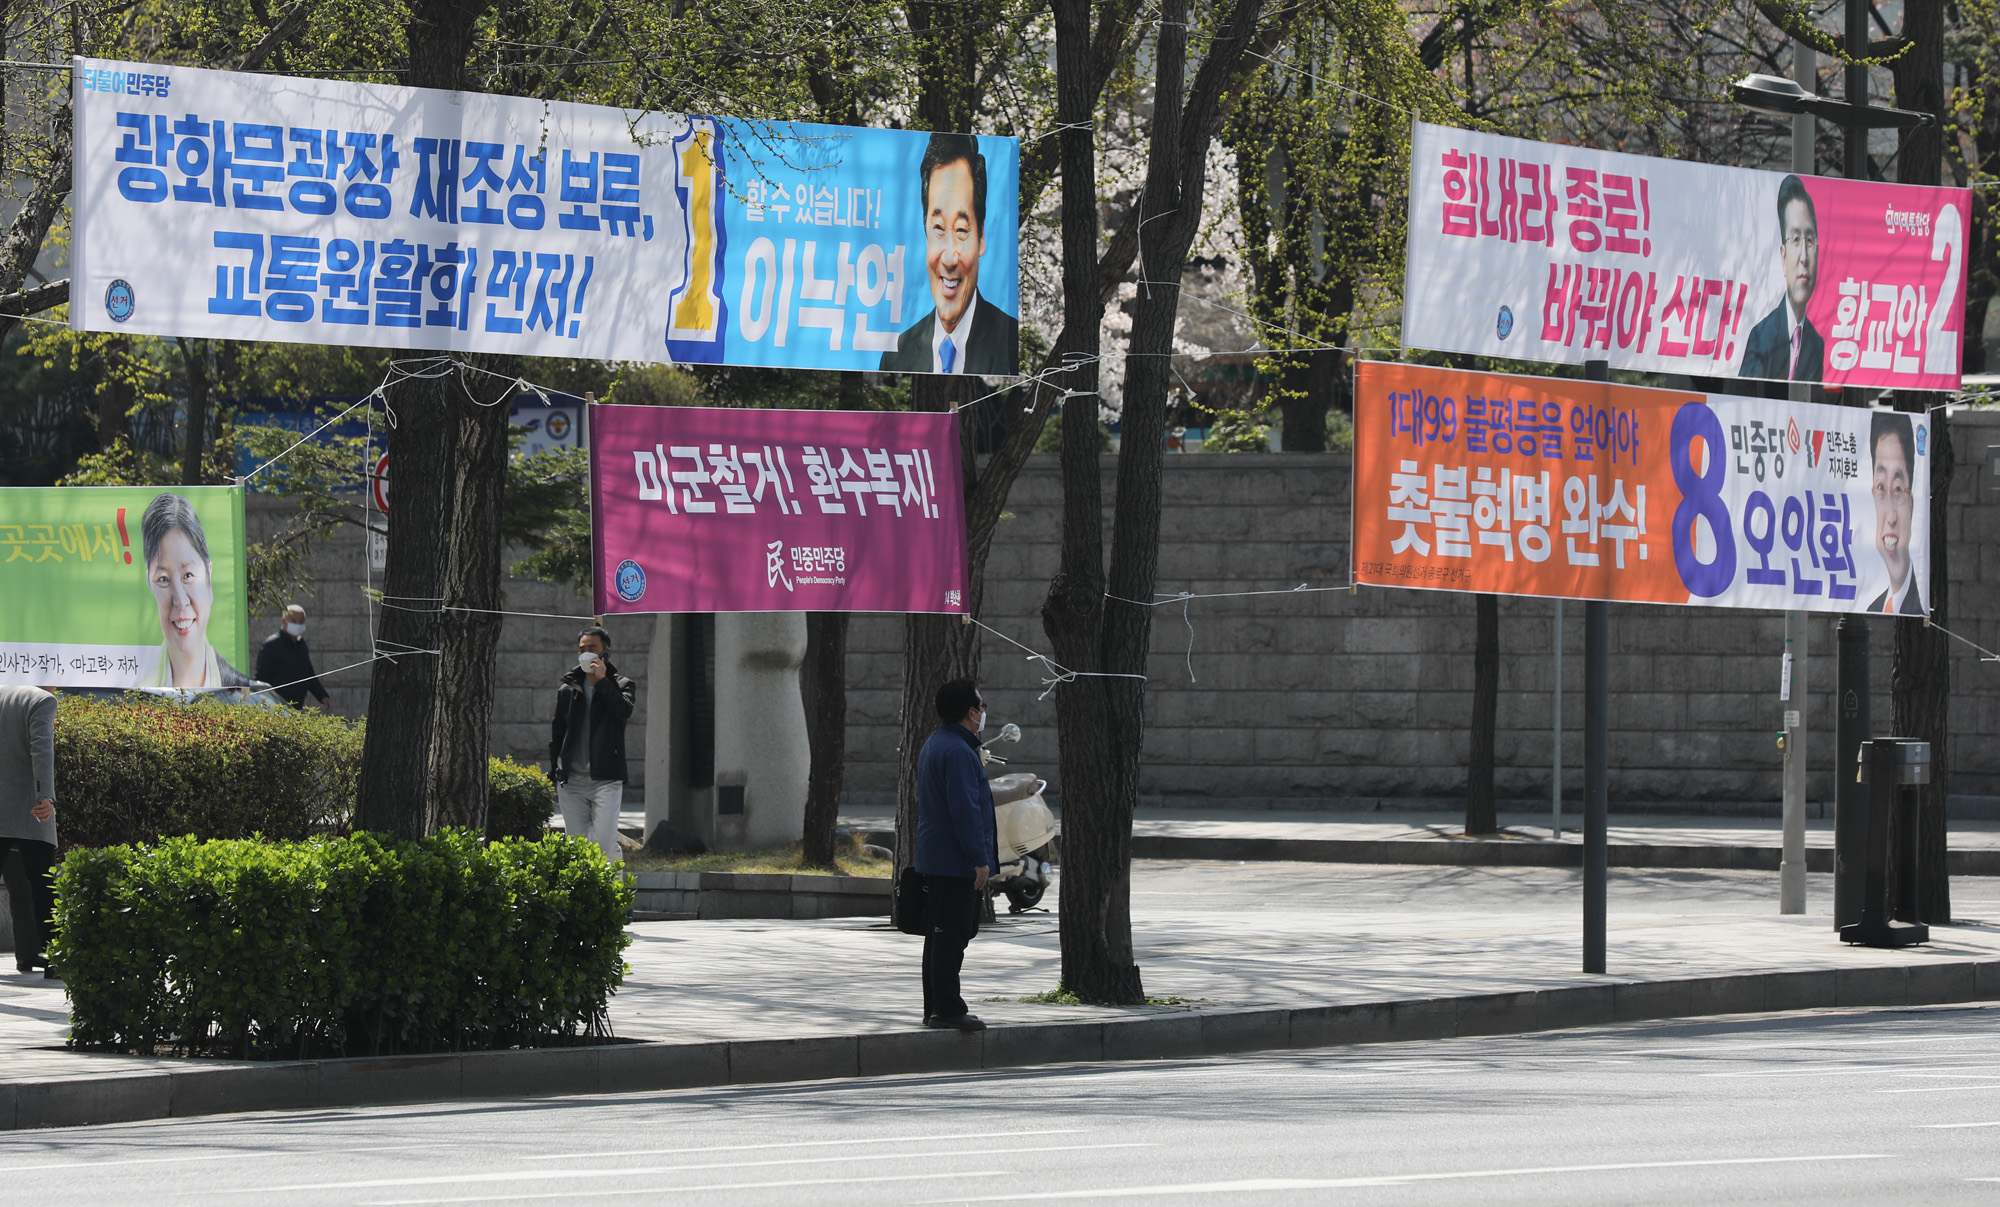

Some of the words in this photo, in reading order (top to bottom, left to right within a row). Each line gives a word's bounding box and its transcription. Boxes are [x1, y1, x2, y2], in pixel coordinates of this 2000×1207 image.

[84, 69, 171, 98] 더불어민주당
[115, 111, 399, 220] 광화문광장
[409, 137, 547, 231] 재조성
[558, 149, 655, 242] 보류,
[794, 184, 882, 229] 있습니다!
[1441, 148, 1557, 247] 힘내라
[1566, 167, 1652, 258] 종로!
[665, 114, 728, 365] 1
[111, 295, 128, 309] 선거
[208, 231, 477, 331] 교통원활화
[485, 250, 594, 339] 먼저!
[740, 237, 906, 353] 이낙연
[1540, 263, 1657, 354] 바꿔야
[1657, 275, 1748, 361] 산다!
[1924, 203, 1963, 375] 2
[1830, 276, 1929, 374] 황교안
[1388, 389, 1457, 447] 1대99
[1463, 395, 1564, 460] 불평등을
[1570, 404, 1639, 466] 엎어야
[1731, 420, 1785, 483] 민중당
[1826, 430, 1857, 455] 민주노총
[633, 443, 802, 516] 미군철거!
[802, 445, 939, 519] 환수복지!
[1670, 401, 1737, 598] 8
[1829, 456, 1858, 480] 지지후보
[1387, 459, 1552, 563] 촛불혁명
[1561, 474, 1649, 570] 완수!
[1743, 490, 1857, 600] 오인환
[622, 573, 640, 590] 선거
[766, 540, 794, 592] 民
[790, 546, 845, 572] 민중민주당
[796, 576, 813, 586] People's
[813, 576, 835, 586] Democracy
[835, 576, 846, 586] Party
[117, 655, 139, 675] 저자
